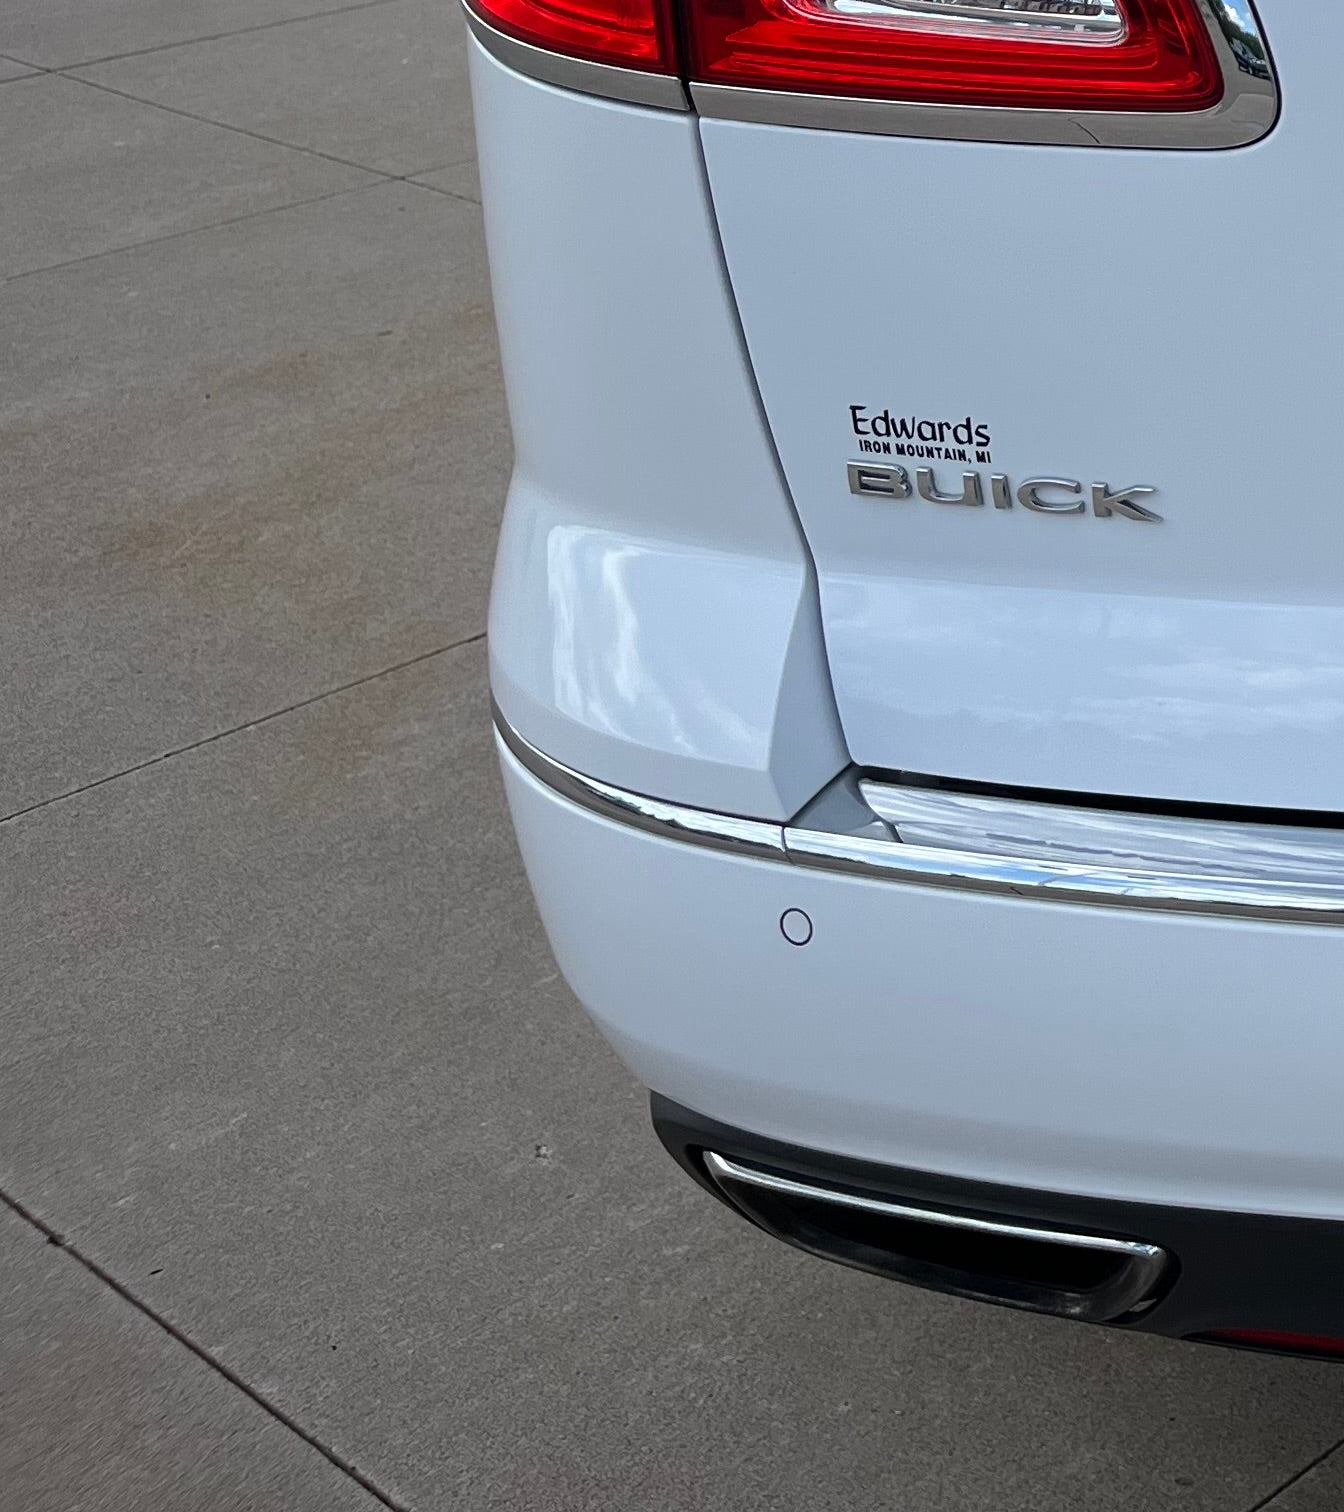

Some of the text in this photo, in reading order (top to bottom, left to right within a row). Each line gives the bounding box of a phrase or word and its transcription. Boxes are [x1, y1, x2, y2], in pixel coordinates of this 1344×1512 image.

[849, 405, 991, 447] Edwards
[858, 439, 992, 465] IRON MOUNTAIN, MI
[846, 459, 1165, 524] BUICK
